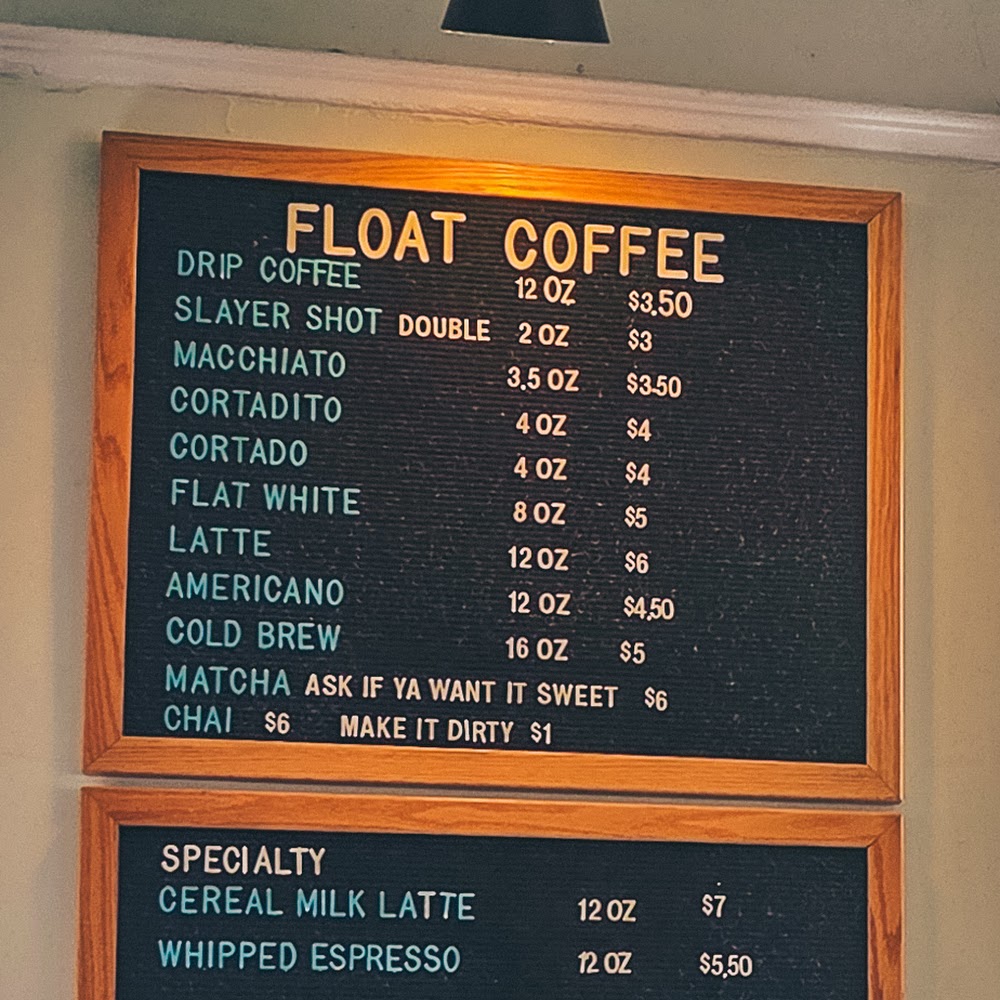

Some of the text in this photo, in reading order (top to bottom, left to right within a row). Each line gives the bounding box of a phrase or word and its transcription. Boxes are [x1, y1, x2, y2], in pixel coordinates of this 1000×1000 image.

[286, 202, 726, 284] FLOAT COFFEE
[177, 249, 243, 280] DRIP
[259, 255, 362, 289] COFFEE
[514, 275, 539, 300] 12
[542, 274, 577, 307] OZ
[174, 295, 653, 352] SLAYER SHOT DOUBLE 2 OZ $3
[173, 339, 346, 378] MACCHIATO
[506, 365, 541, 391] 3.5
[546, 367, 580, 392] OZ
[170, 385, 653, 443] CORTADITO 4 OZ $4
[169, 431, 652, 487] CORTADO 4 OZ $4
[171, 478, 648, 529] FLAT WHITE 8 OZ $5
[169, 524, 650, 574] LATTE 12 OZ $6
[165, 571, 344, 606] AMERICANO
[507, 590, 531, 614] 12
[538, 592, 571, 616] OZ
[166, 616, 646, 665] COLD BREW 16 OZ $5
[165, 663, 668, 712] MATCHA ASK IF YA WANT IT SWEET $6
[163, 704, 552, 745] CHAI $6 MAKE IT DIRTY $1
[160, 844, 326, 876] SPECIALTY
[158, 885, 727, 923] CEREAL MILK LATTE 12 OZ $7
[157, 939, 298, 972] WHIPPED
[311, 942, 461, 974] ESPRESSO
[577, 950, 600, 974] 12
[603, 951, 633, 974] OZ
